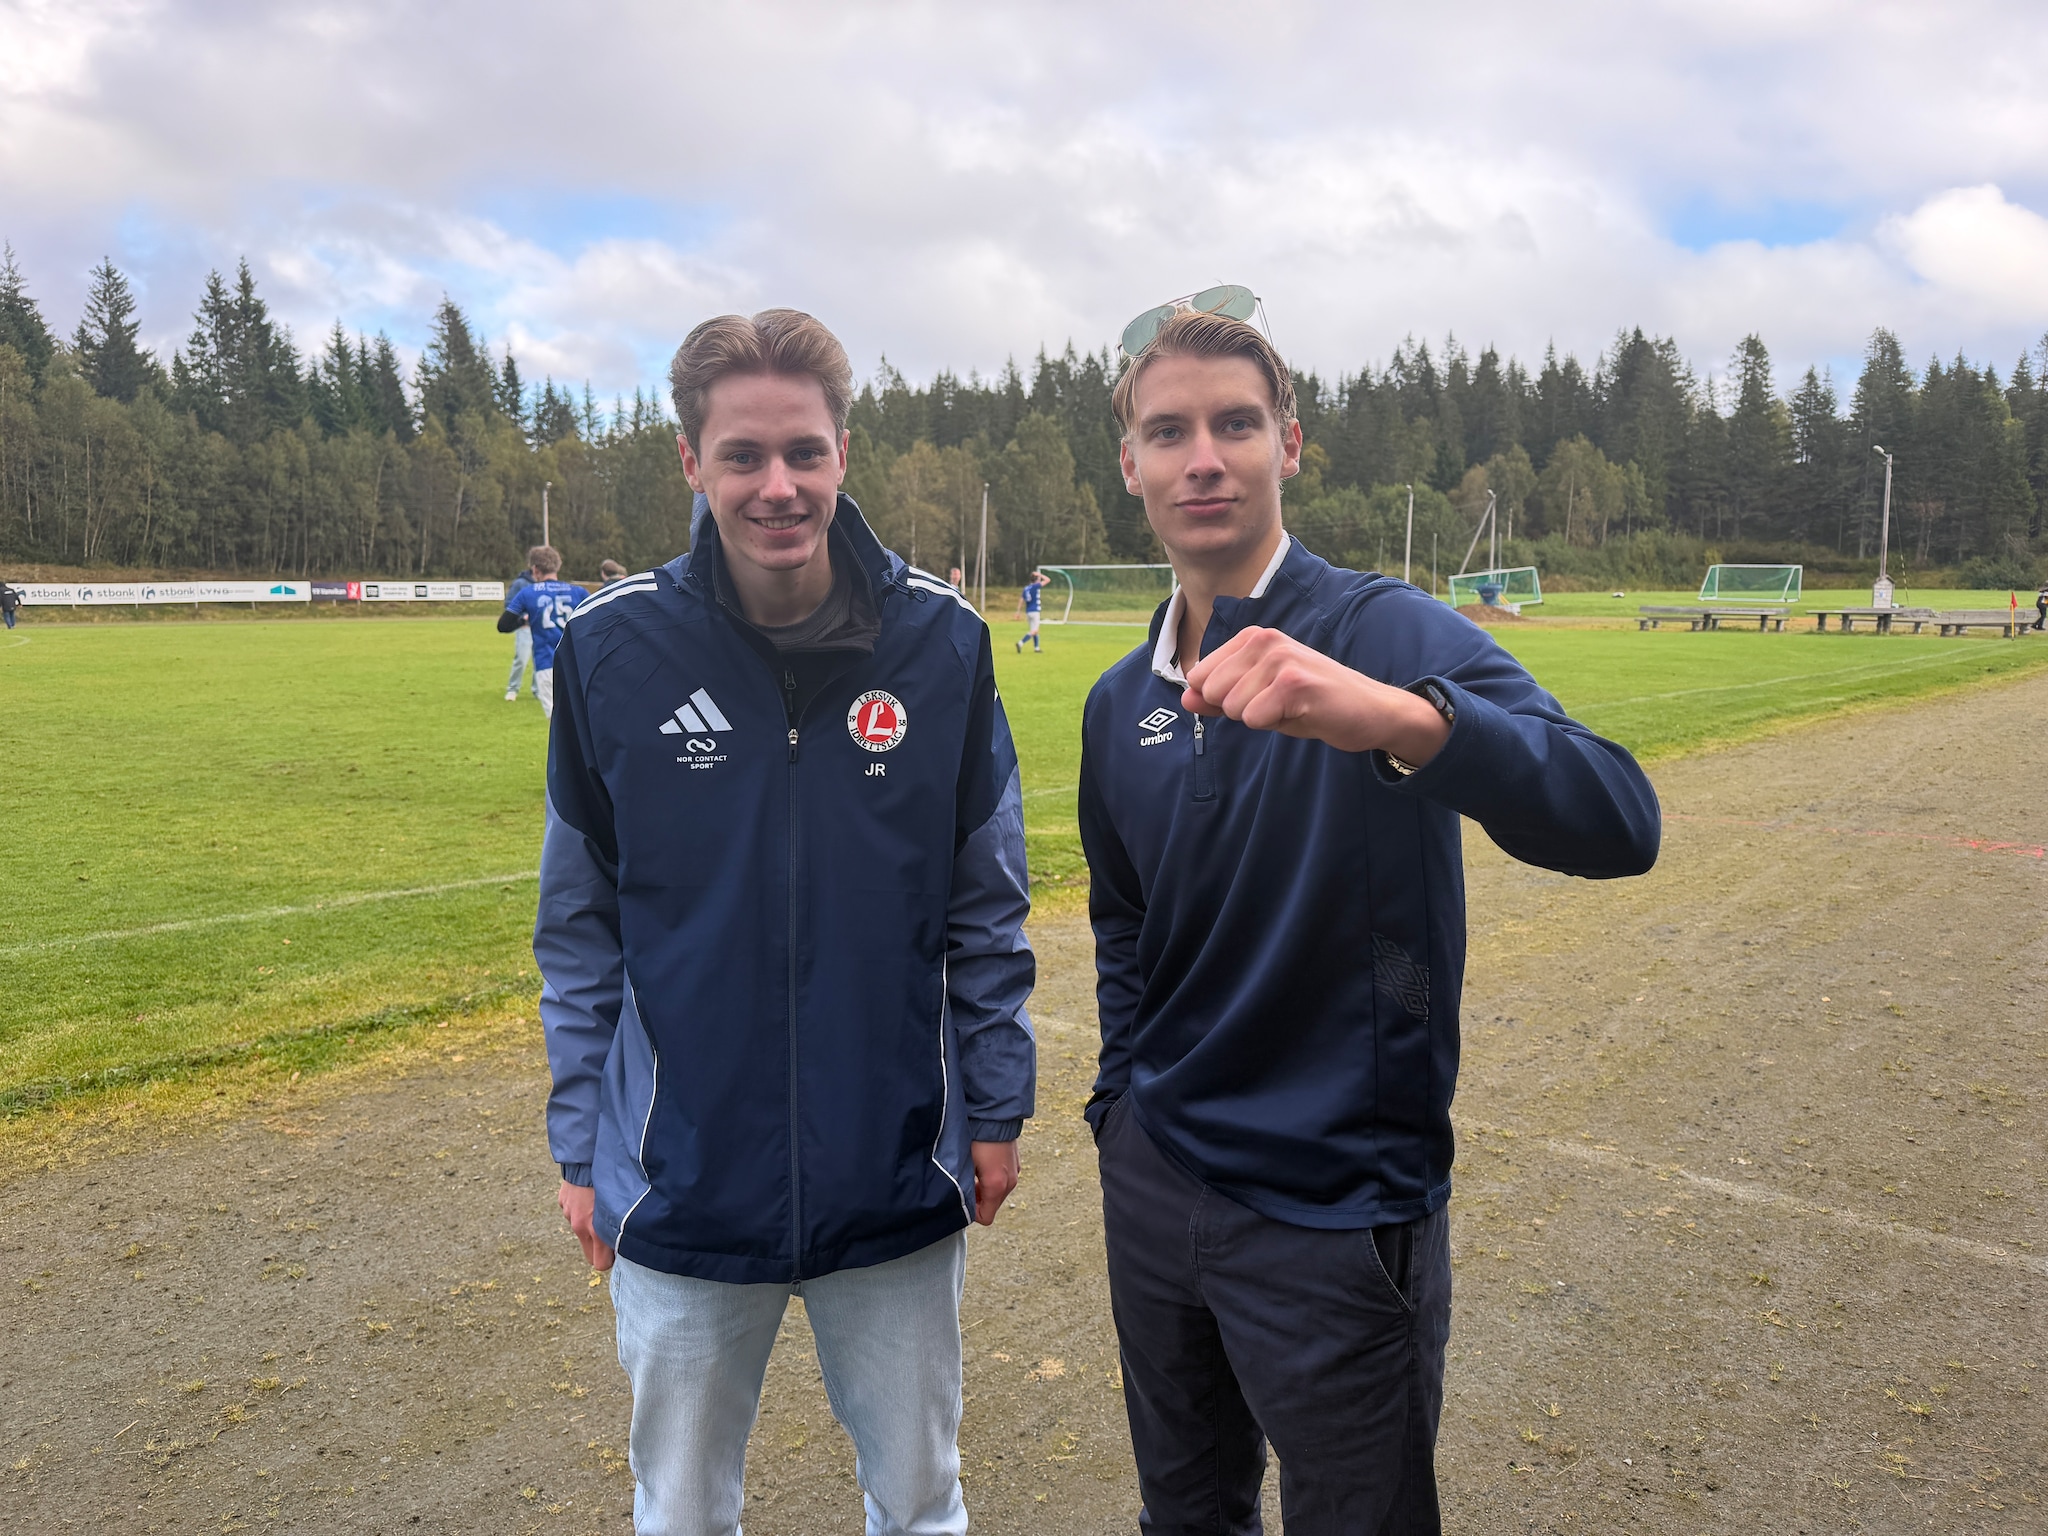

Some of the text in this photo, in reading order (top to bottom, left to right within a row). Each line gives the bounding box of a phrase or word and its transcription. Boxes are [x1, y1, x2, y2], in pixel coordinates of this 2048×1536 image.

[537, 591, 573, 619] 25
[858, 691, 898, 709] LEKSVIK
[898, 719, 906, 727] 38
[850, 727, 903, 751] IDRETTSLAG
[1140, 731, 1173, 746] umbro
[694, 755, 728, 763] CONTACT
[864, 762, 886, 777] JR
